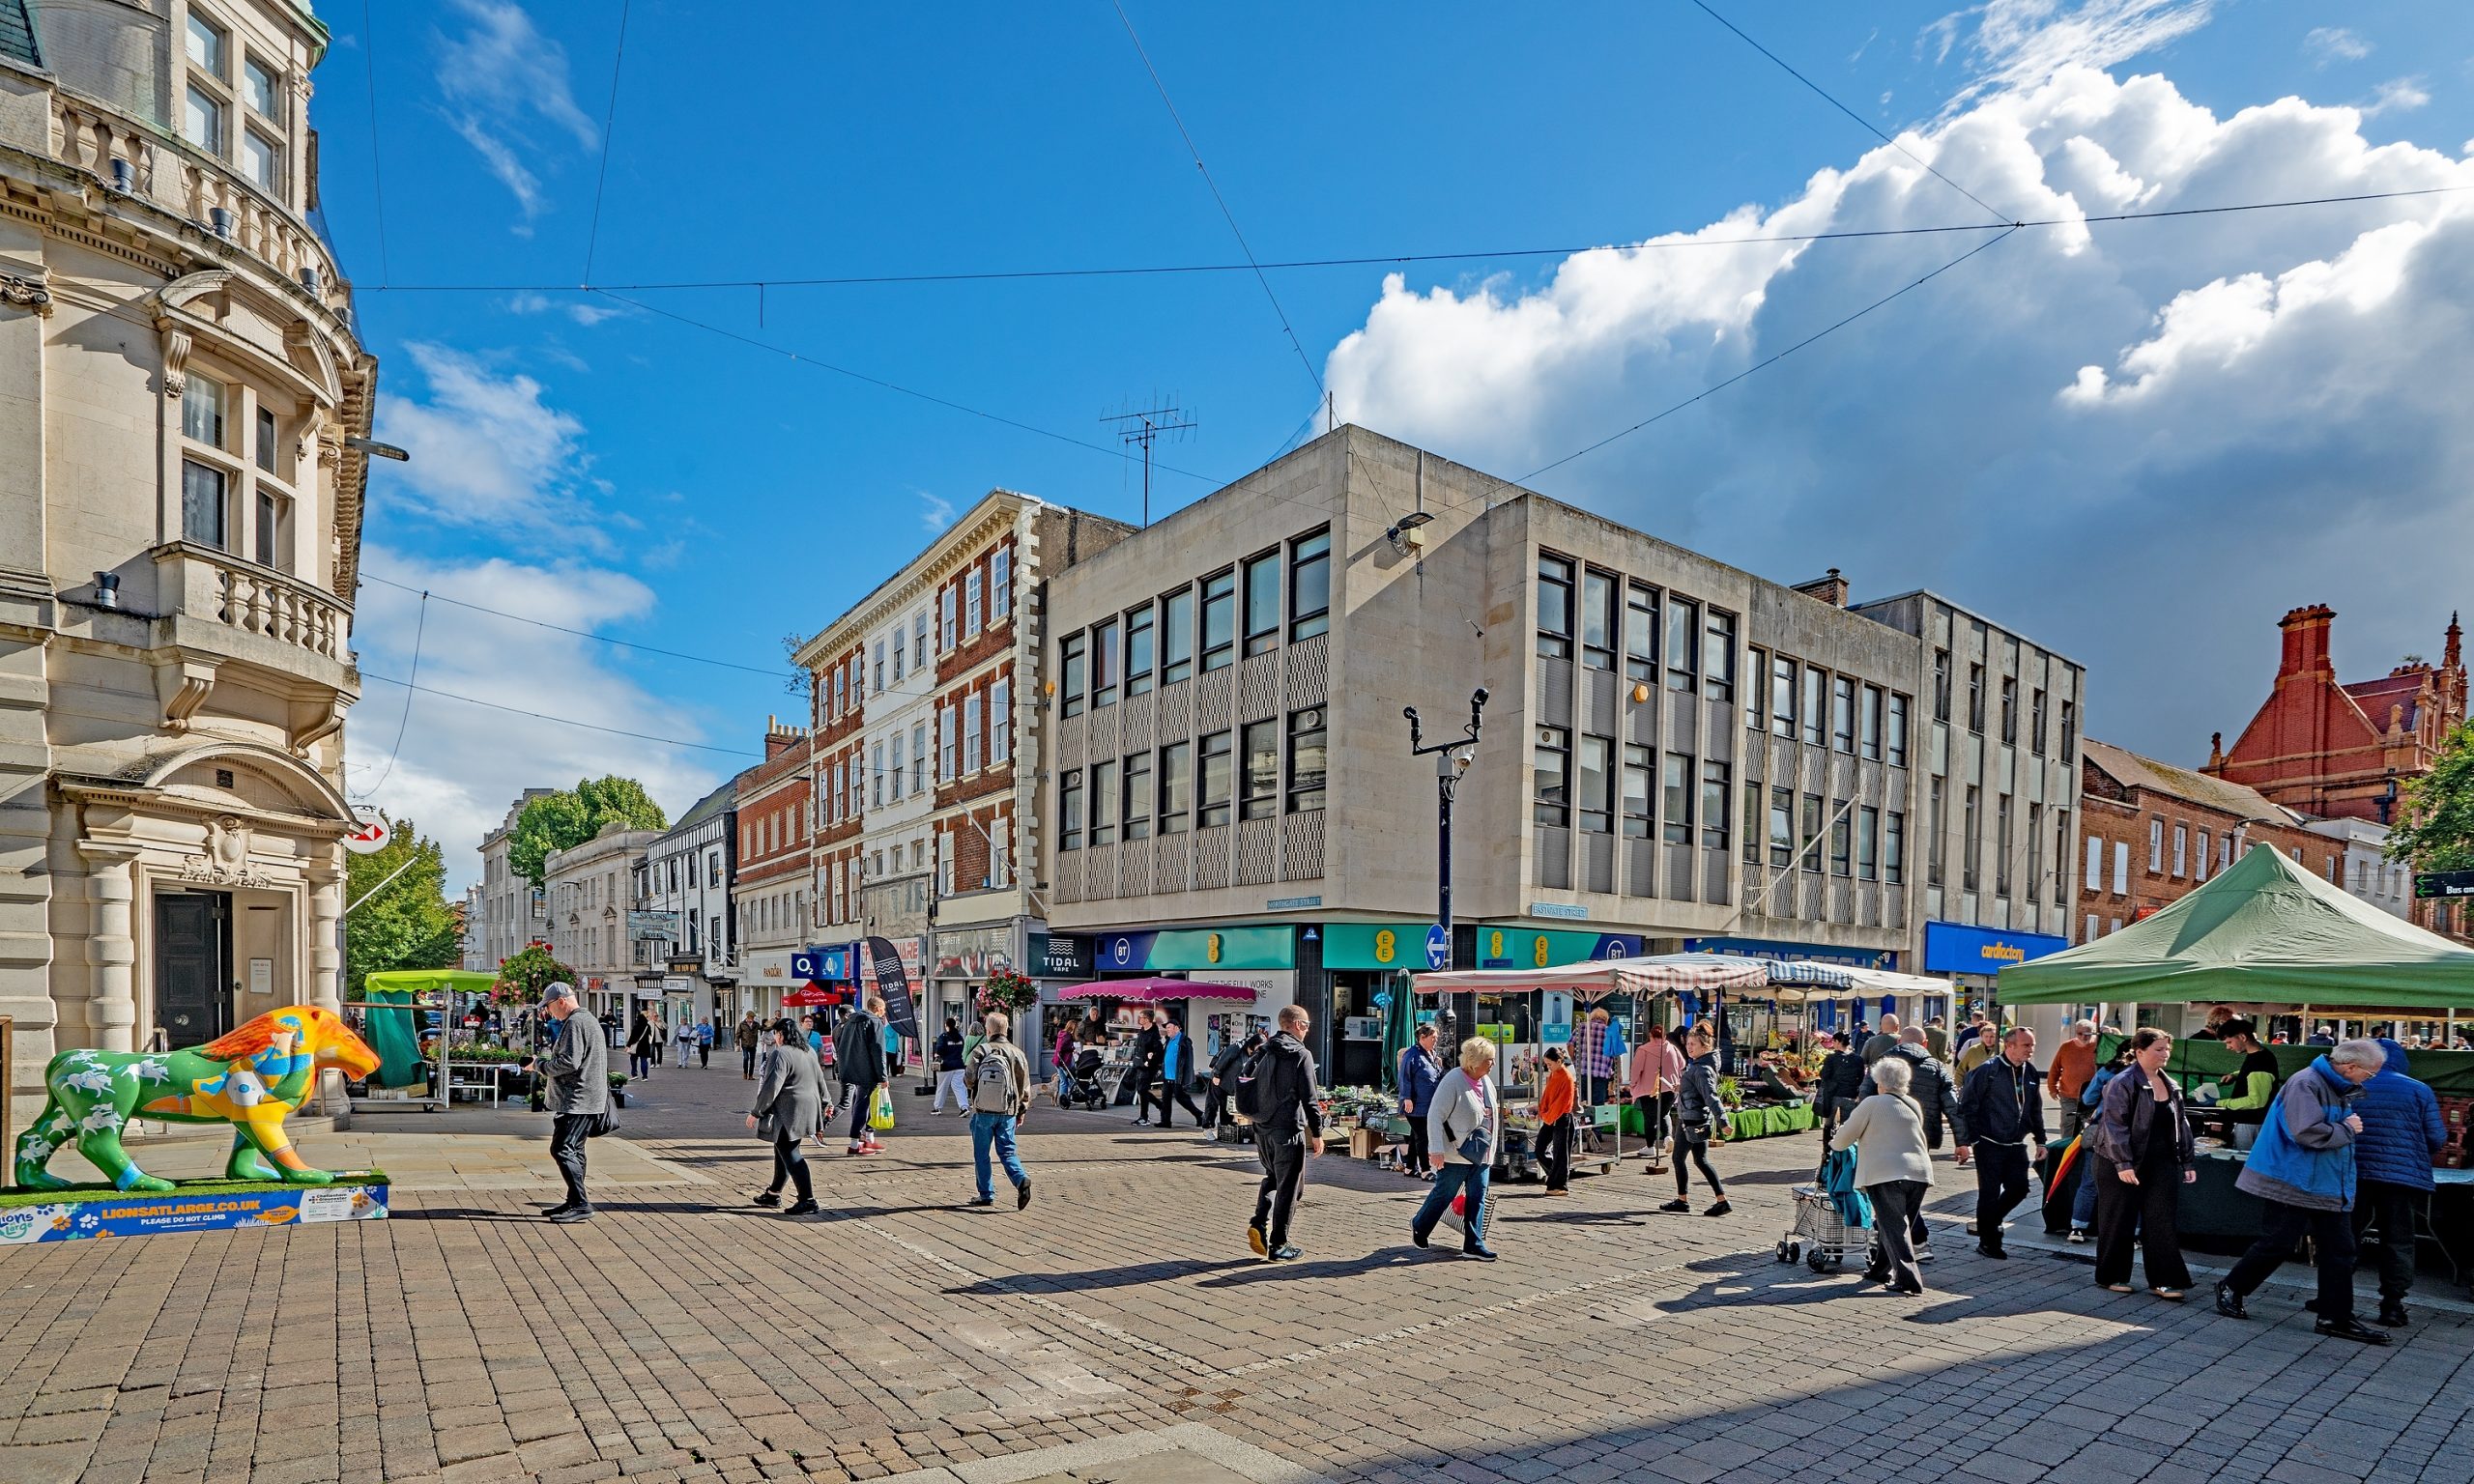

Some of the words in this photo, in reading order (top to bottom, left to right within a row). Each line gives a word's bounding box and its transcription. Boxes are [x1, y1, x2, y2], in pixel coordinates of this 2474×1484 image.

[2446, 886, 2462, 895] Bus
[1268, 899, 1299, 908] NORTHGATE
[1300, 898, 1320, 906] STREET
[1534, 904, 1564, 915] EASTGATE
[1565, 908, 1586, 917] STREET
[1118, 946, 1127, 956] BT
[1610, 949, 1622, 959] BT
[1981, 941, 2025, 964] cardfactory
[989, 954, 1010, 965] TIDAL
[1043, 956, 1079, 967] TIDAL
[796, 957, 814, 975] O2
[880, 980, 905, 990] TIDAL
[1249, 980, 1274, 989] WORKS
[101, 1199, 261, 1219] LIONSATLARGE.CO.UK
